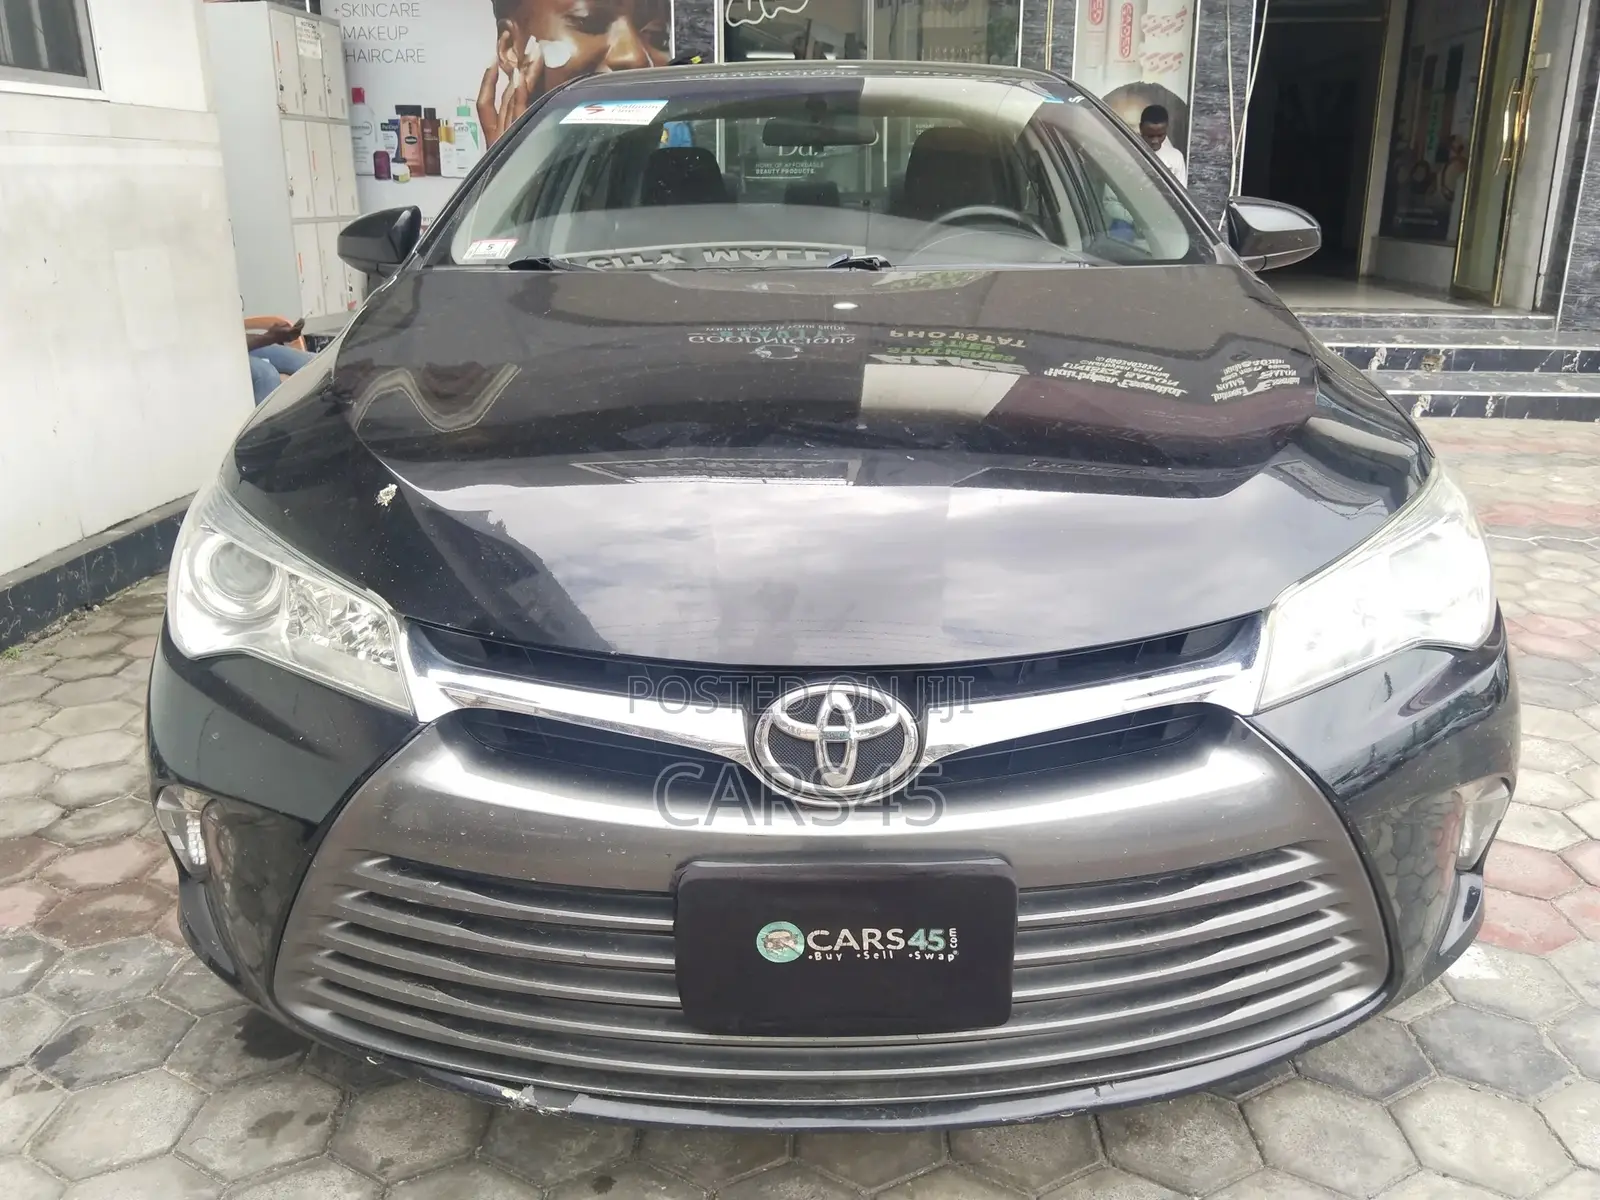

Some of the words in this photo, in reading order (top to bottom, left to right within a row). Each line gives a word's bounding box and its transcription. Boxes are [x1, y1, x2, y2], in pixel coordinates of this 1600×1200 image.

[343, 26, 409, 41] MAKEUP
[345, 48, 426, 64] HAIRCARE
[807, 928, 946, 951] CARS45
